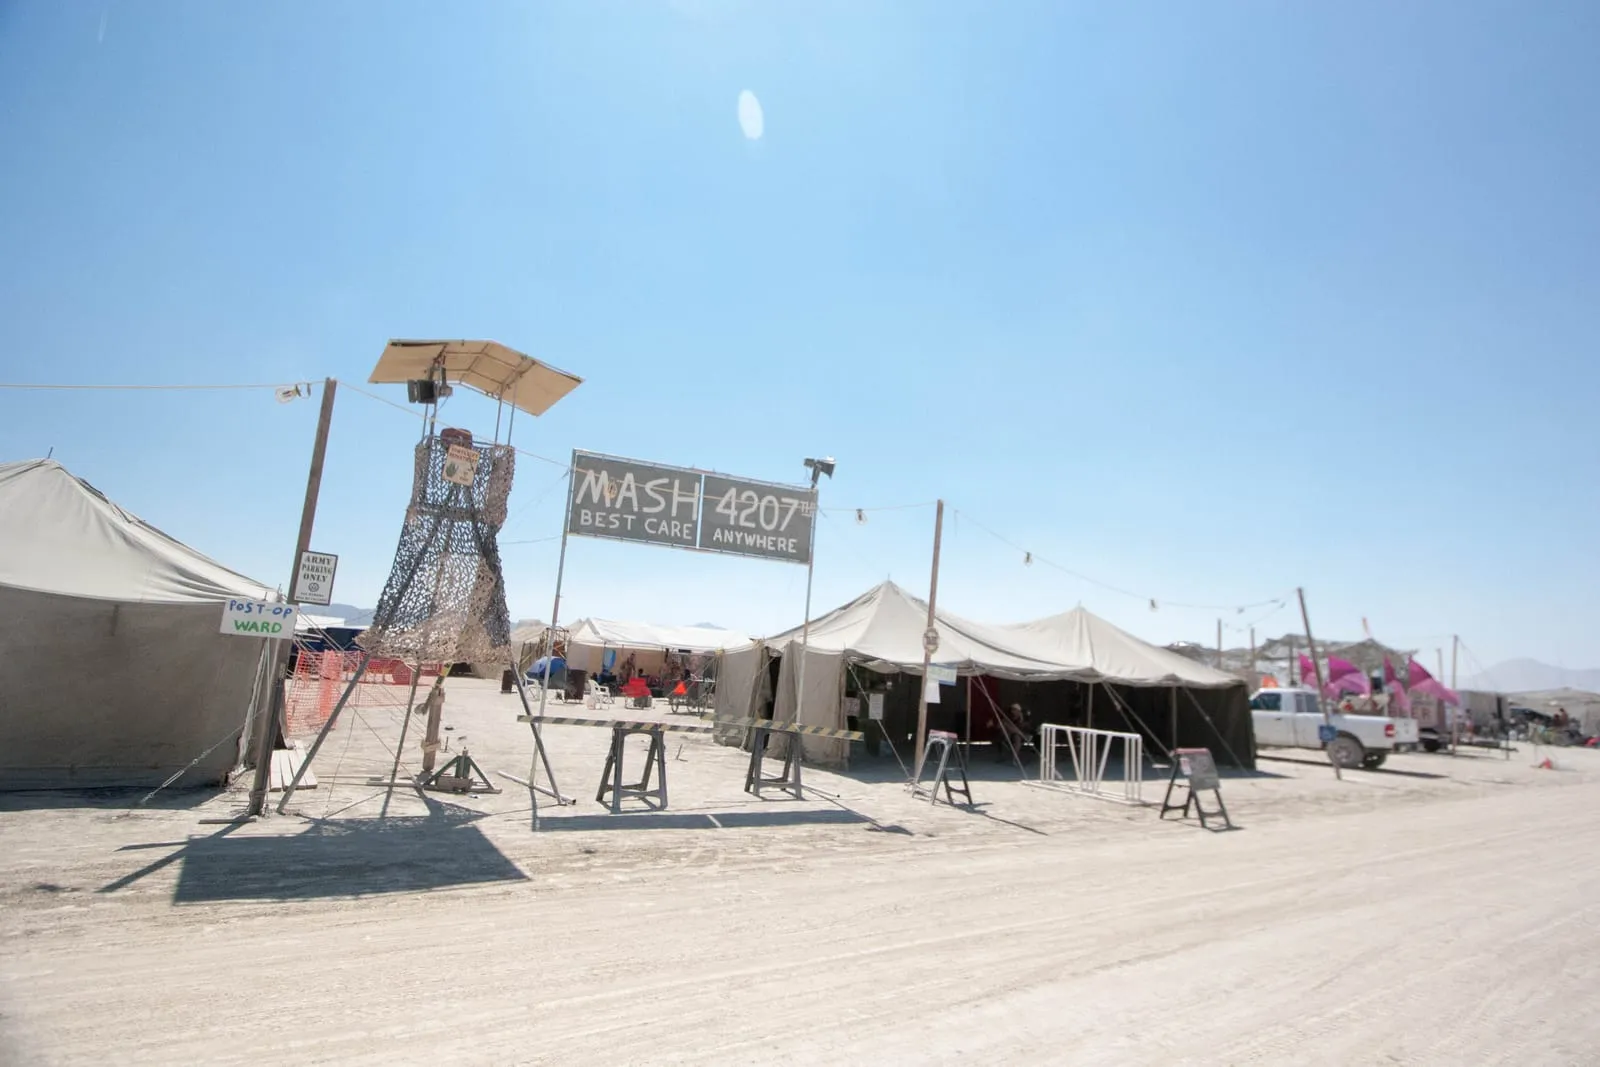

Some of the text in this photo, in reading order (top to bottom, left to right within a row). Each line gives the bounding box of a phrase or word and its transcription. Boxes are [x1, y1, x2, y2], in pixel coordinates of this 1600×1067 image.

[576, 469, 699, 521] MASH
[580, 511, 798, 553] BEST CARE ANYWHERE
[305, 556, 331, 565] ARMY
[302, 564, 332, 574] PARKING
[303, 573, 327, 582] ONLY
[234, 619, 282, 633] WARD
